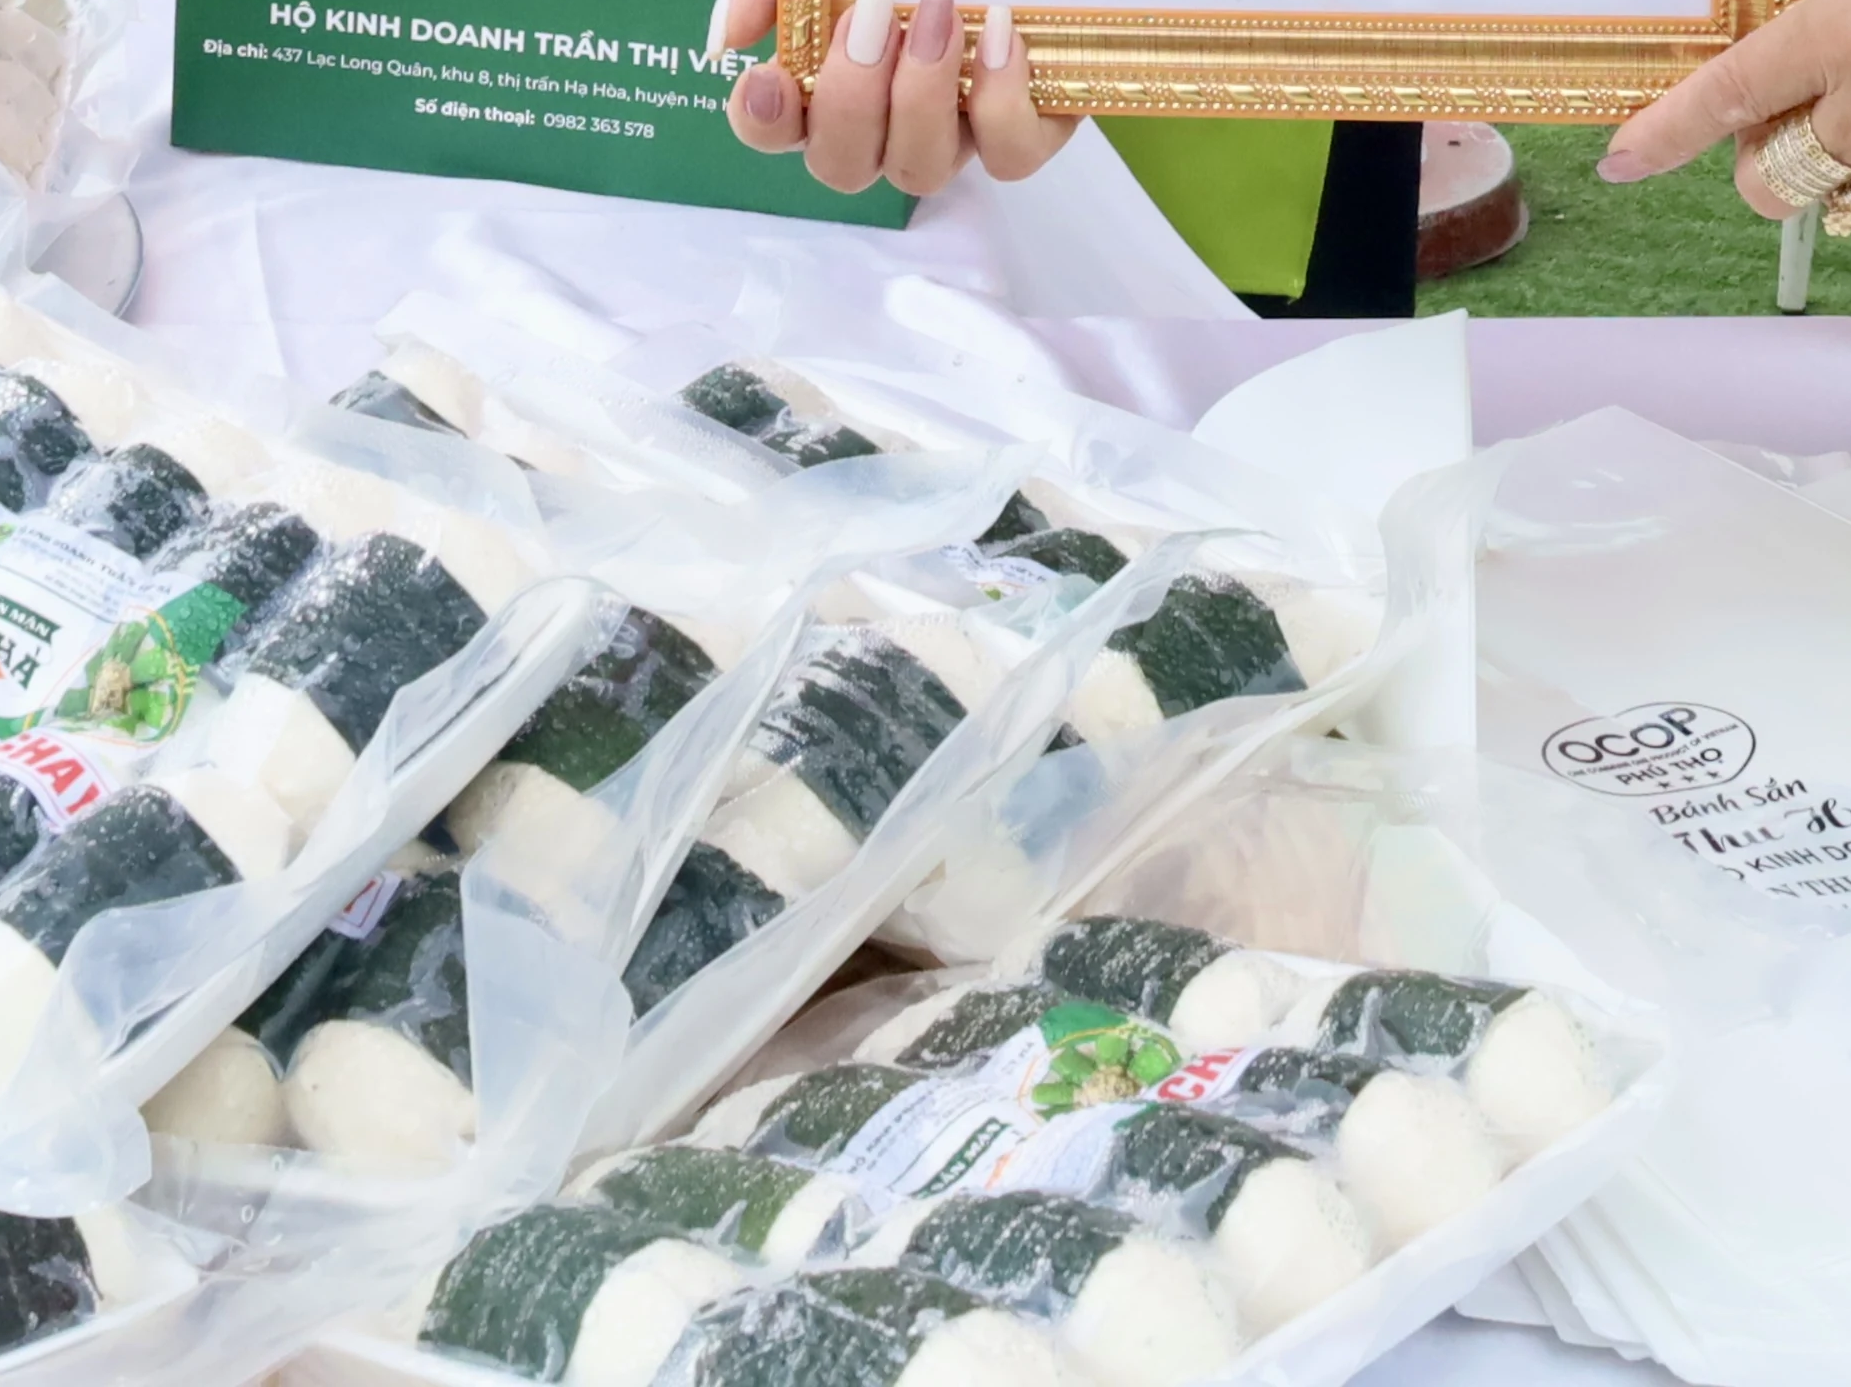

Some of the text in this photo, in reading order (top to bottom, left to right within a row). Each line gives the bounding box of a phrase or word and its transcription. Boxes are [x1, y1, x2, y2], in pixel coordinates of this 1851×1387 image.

[269, 0, 317, 34] HỘ
[325, 8, 401, 38] KINH
[410, 18, 525, 53] DOANH
[534, 30, 619, 62] TRẦN
[628, 42, 679, 75] THỊ
[203, 38, 717, 111] Địa chỉ: 437 Lạc Long Quân, khu 8, thị trấn Hạ Hòa, huyện Hạ
[414, 98, 655, 138] Số điện thoại: 0982 363 578
[1558, 707, 1697, 764] OCOP
[1650, 793, 1743, 826] Bánh
[1745, 846, 1824, 873] KINH
